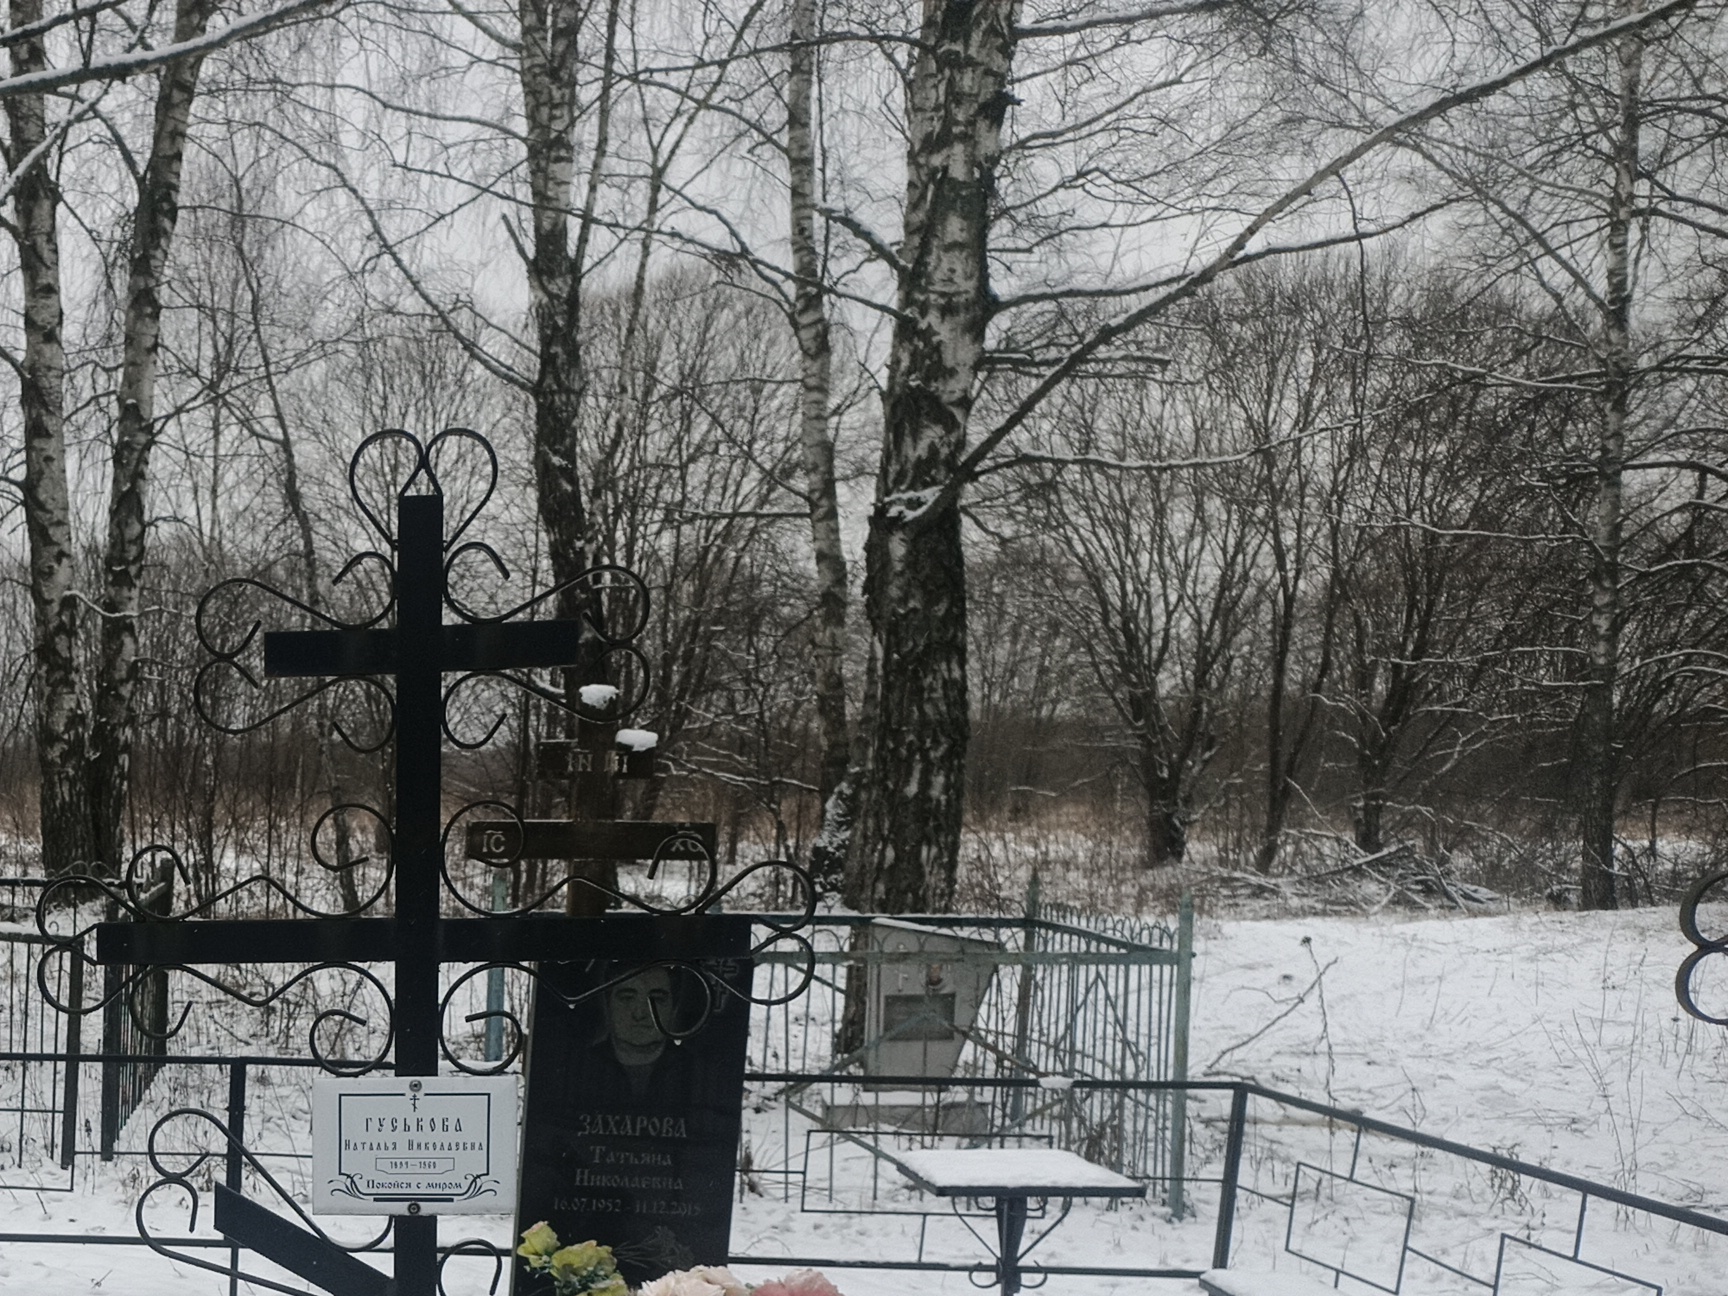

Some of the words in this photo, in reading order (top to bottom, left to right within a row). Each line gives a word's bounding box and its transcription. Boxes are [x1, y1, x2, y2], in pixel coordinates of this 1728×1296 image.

[365, 1116, 464, 1133] ГУСЬКОВА
[576, 1113, 688, 1139] ЗАХАРОВА
[366, 1179, 412, 1189] Покойся
[425, 1182, 463, 1192] миром
